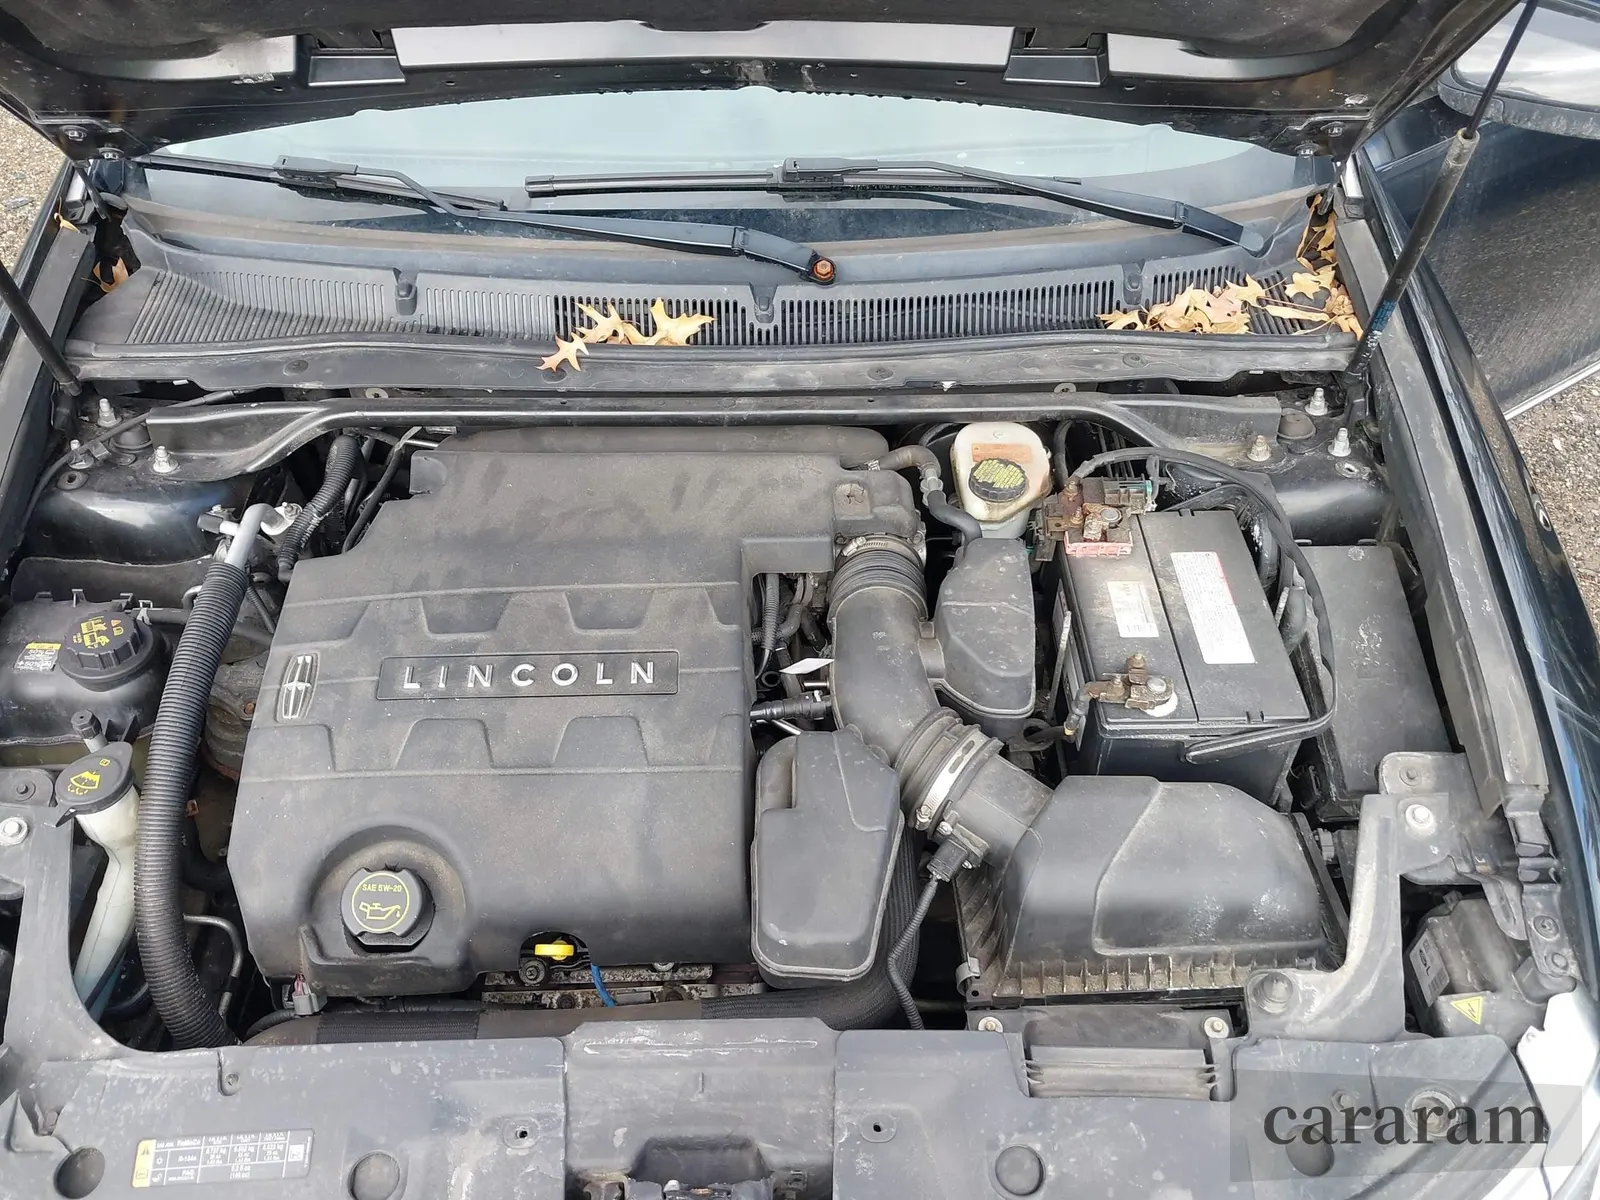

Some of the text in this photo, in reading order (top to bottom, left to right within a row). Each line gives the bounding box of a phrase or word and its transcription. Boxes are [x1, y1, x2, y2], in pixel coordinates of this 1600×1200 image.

[403, 661, 655, 690] LINCOLN
[362, 883, 402, 893] SAE 5W-20
